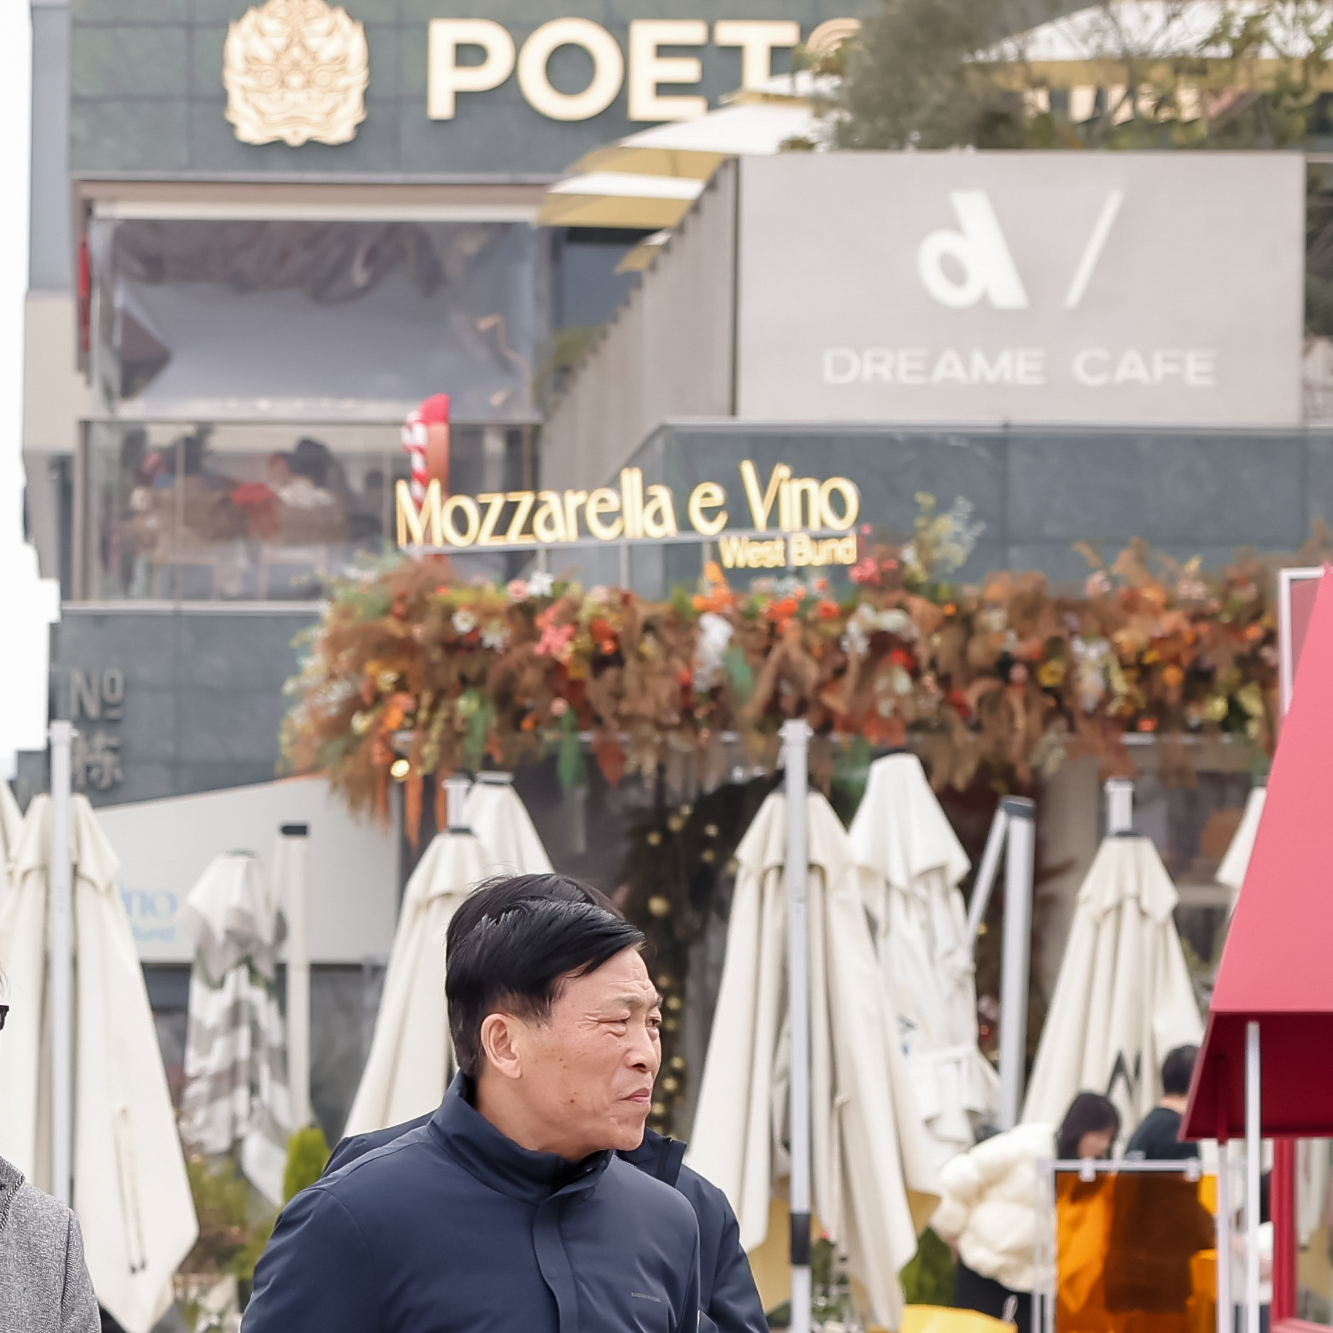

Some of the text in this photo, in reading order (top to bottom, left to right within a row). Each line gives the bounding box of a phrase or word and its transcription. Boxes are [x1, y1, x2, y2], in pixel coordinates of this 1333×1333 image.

[822, 347, 1216, 387] DREAME CAFE
[395, 458, 860, 548] Mozzarella e Vino
[718, 532, 858, 569] West Bund
